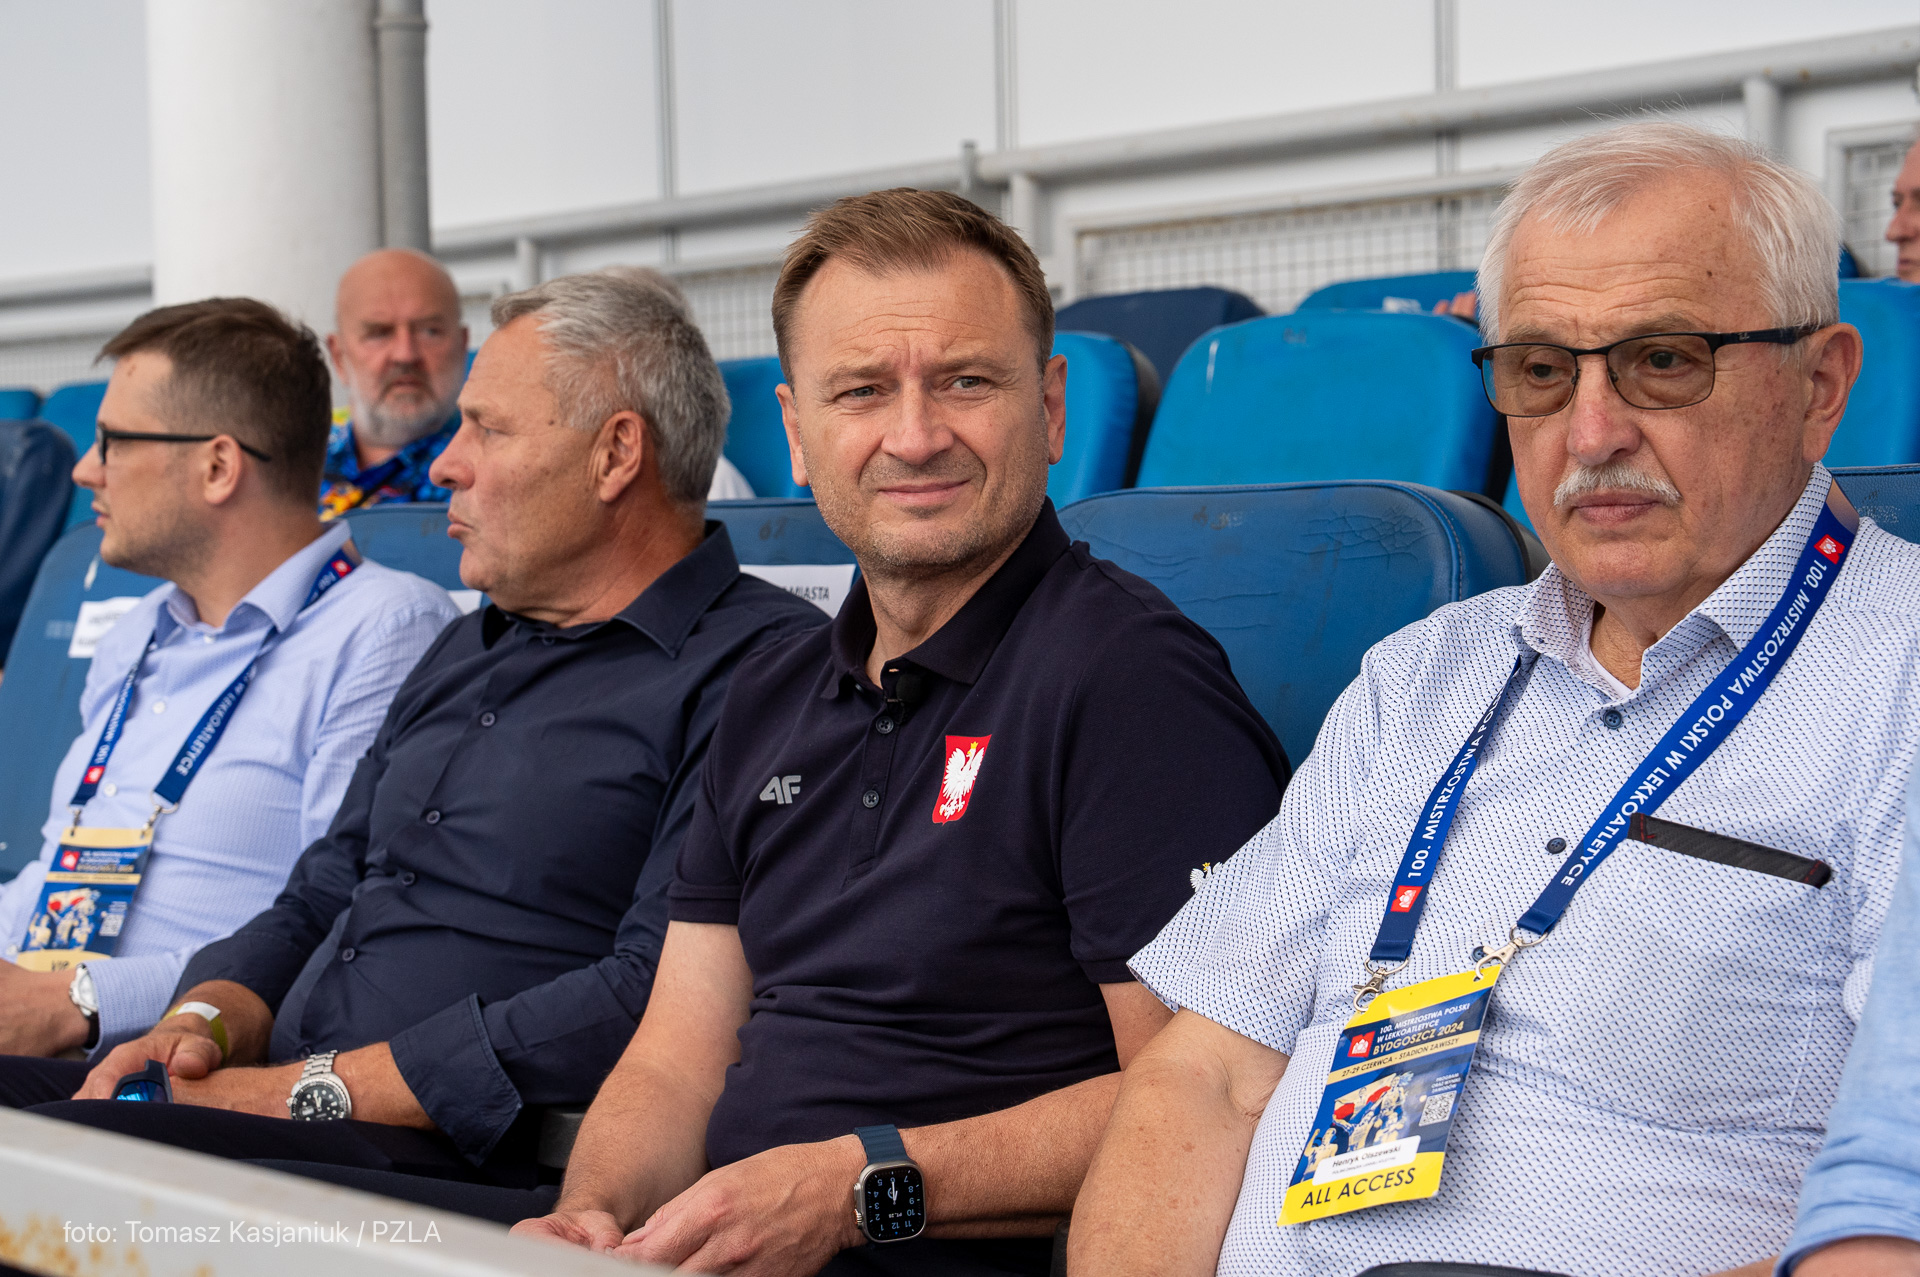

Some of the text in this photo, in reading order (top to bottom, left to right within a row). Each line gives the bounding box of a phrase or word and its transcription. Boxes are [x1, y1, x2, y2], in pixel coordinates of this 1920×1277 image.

[1561, 559, 1827, 886] 100. MISTRZOSTWA POLSKI W LEKKOATLETYCE
[760, 775, 801, 804] 4F
[1408, 845, 1430, 878] 100.
[1422, 735, 1484, 840] MISTRZOSTWA
[1385, 1019, 1440, 1041] LEKKOATLETYCE
[1394, 1010, 1443, 1029] MISTRZOSTWA
[1444, 1003, 1470, 1015] POLSKI
[1373, 1021, 1464, 1056] BYDGOSZCZ 2024
[1342, 1066, 1360, 1077] 27-29
[1361, 1057, 1393, 1071] CZERWCA
[1399, 1047, 1429, 1060] STADION
[1430, 1038, 1460, 1050] ZAWISZY
[1332, 1155, 1358, 1167] Henryk
[1300, 1167, 1416, 1209] ALL ACCESS
